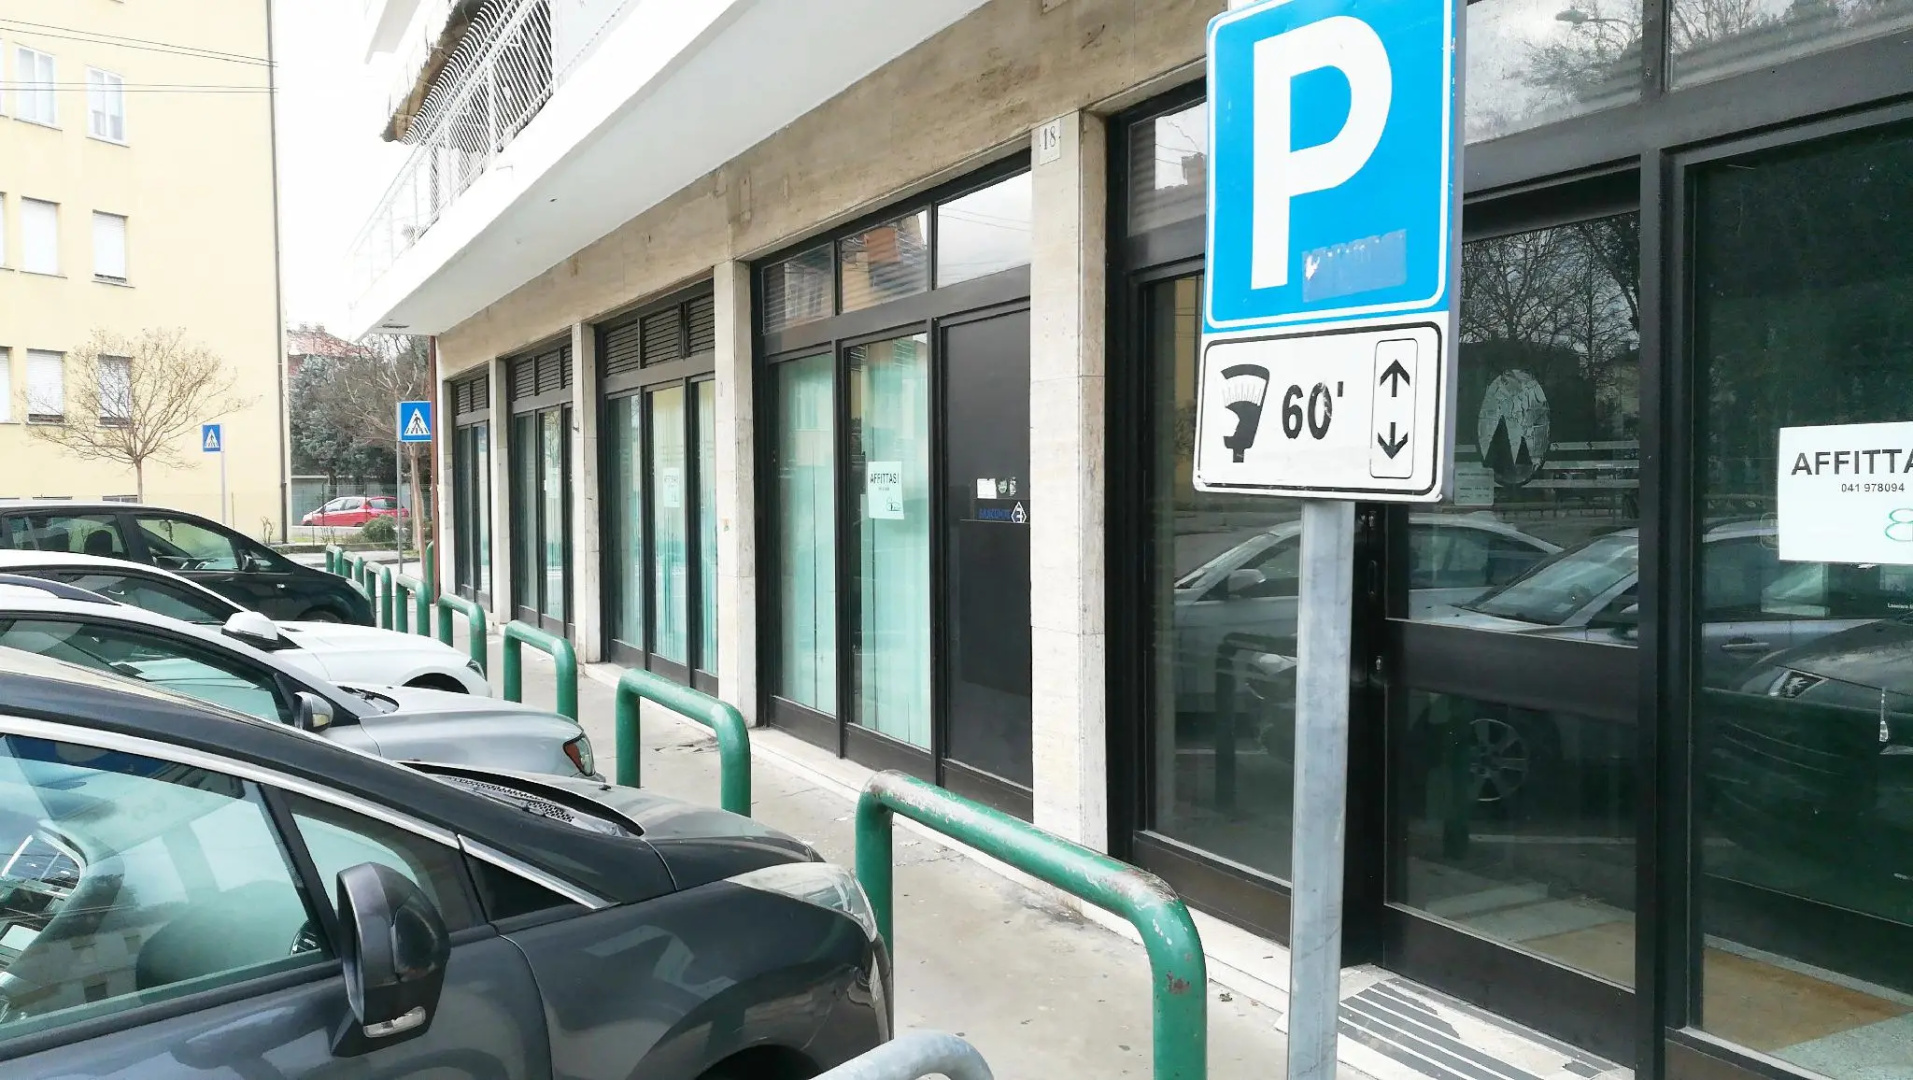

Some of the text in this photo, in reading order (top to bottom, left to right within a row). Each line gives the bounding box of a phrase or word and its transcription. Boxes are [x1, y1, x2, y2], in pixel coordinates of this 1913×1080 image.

[1043, 125, 1057, 150] 18
[1251, 15, 1393, 290] P
[1282, 381, 1344, 440] 60'
[870, 472, 900, 484] AFFITTASI
[1841, 482, 1905, 493] 041 978094
